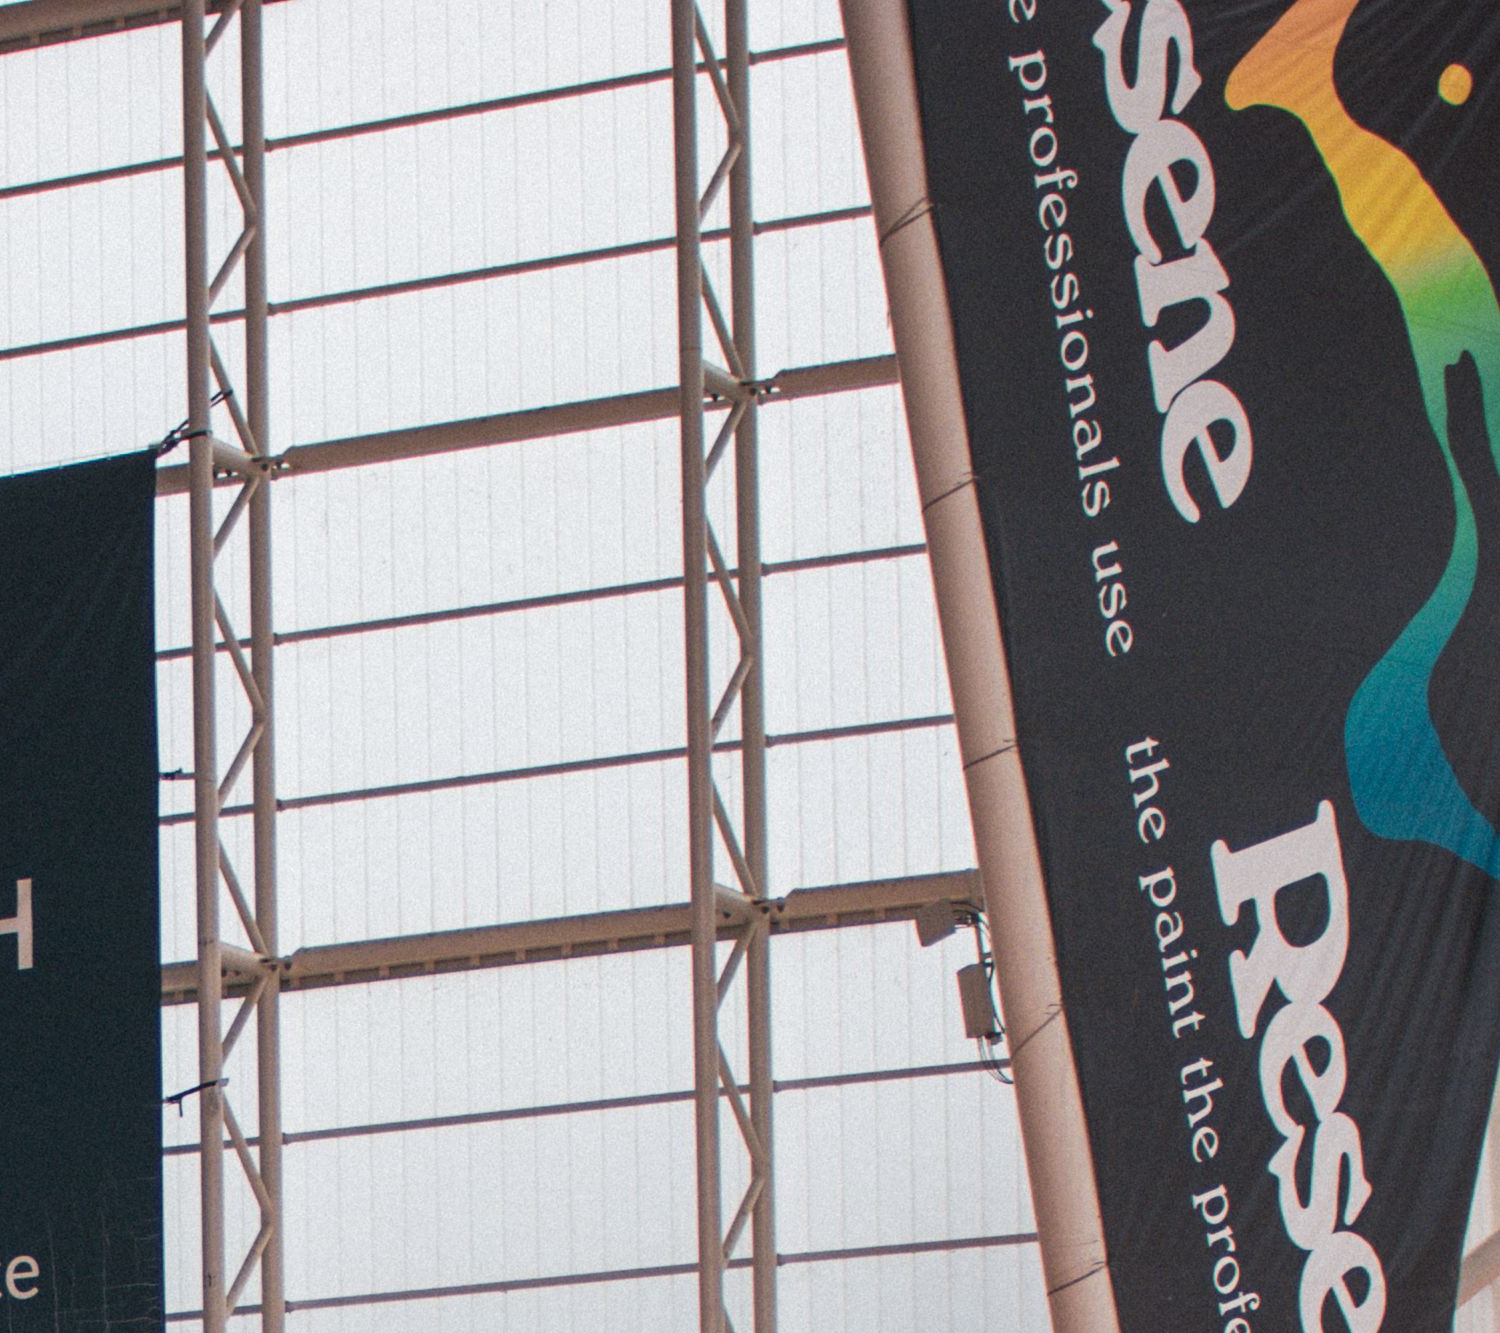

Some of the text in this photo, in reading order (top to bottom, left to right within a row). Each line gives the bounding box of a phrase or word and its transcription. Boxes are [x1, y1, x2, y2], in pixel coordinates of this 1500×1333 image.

[1008, 48, 1135, 658] professionals use
[1125, 736, 1173, 844] the
[1138, 866, 1206, 1039] paint
[1180, 1057, 1224, 1164] the
